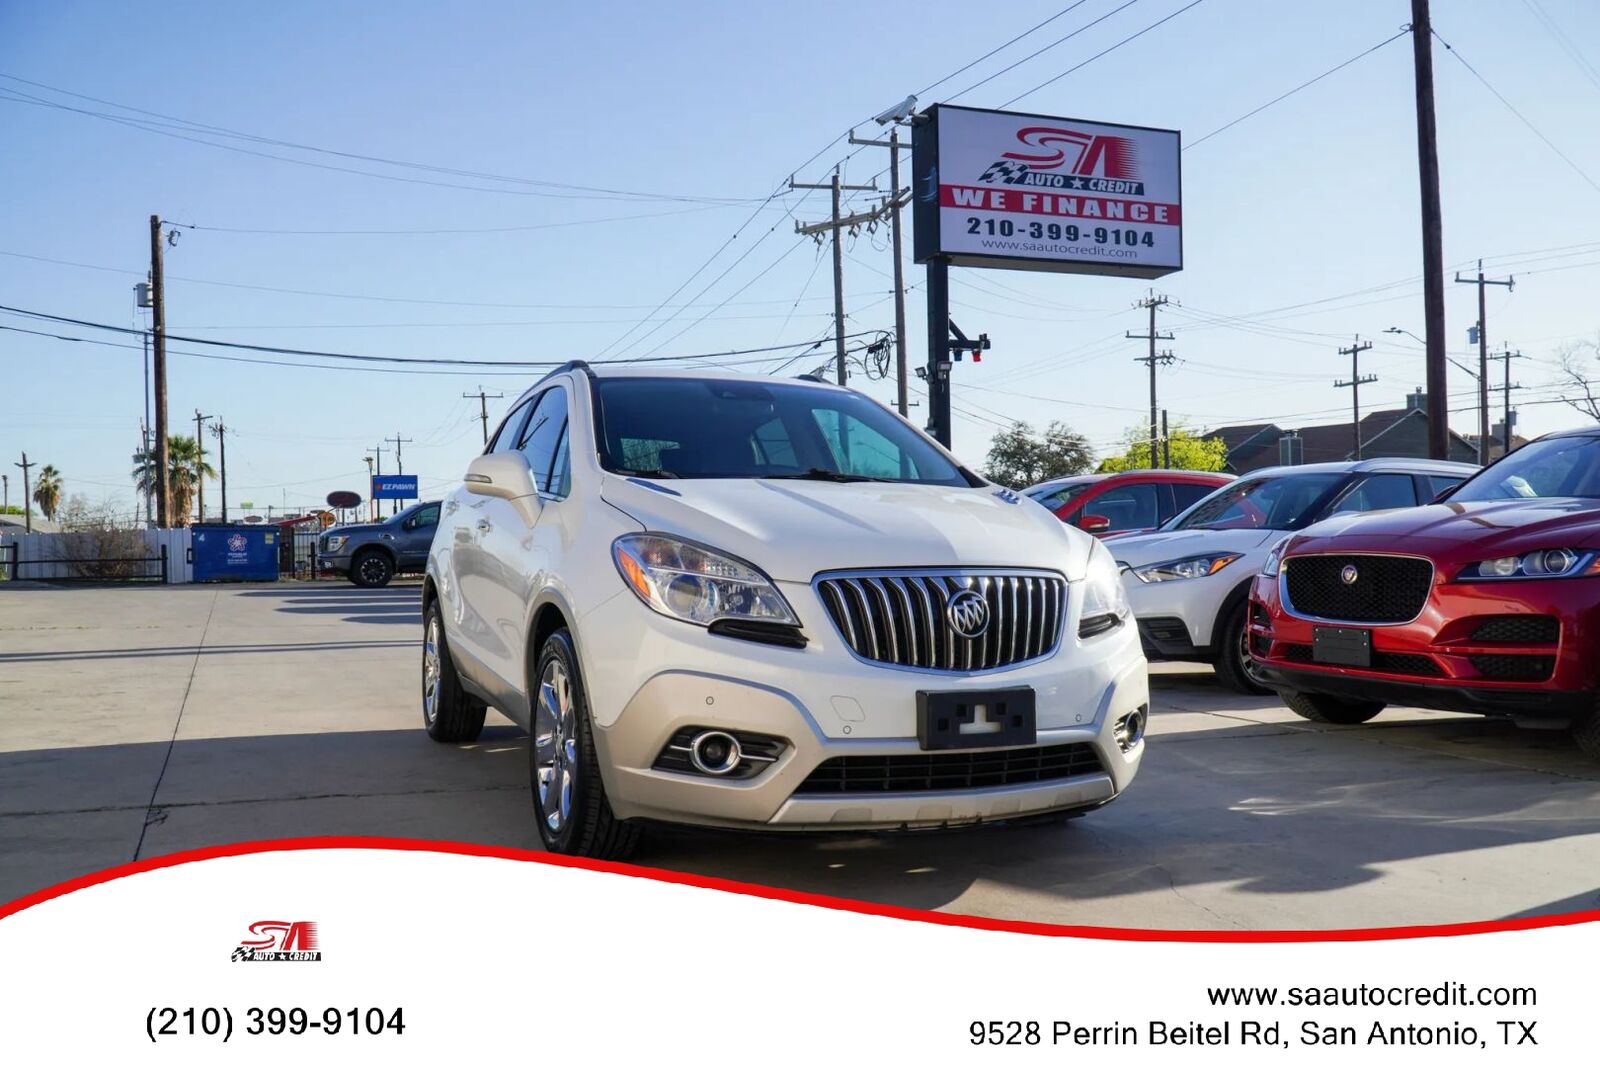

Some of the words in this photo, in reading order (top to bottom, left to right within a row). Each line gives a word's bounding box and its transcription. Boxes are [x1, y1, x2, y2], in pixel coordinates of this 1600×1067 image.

[1023, 173, 1065, 188] AUTO
[1088, 179, 1140, 195] CREDIT
[951, 188, 1006, 209] WE
[1022, 194, 1169, 223] FINANCE
[967, 217, 1155, 248] 210-399-9104
[981, 239, 1138, 259] www.saautocredit.com
